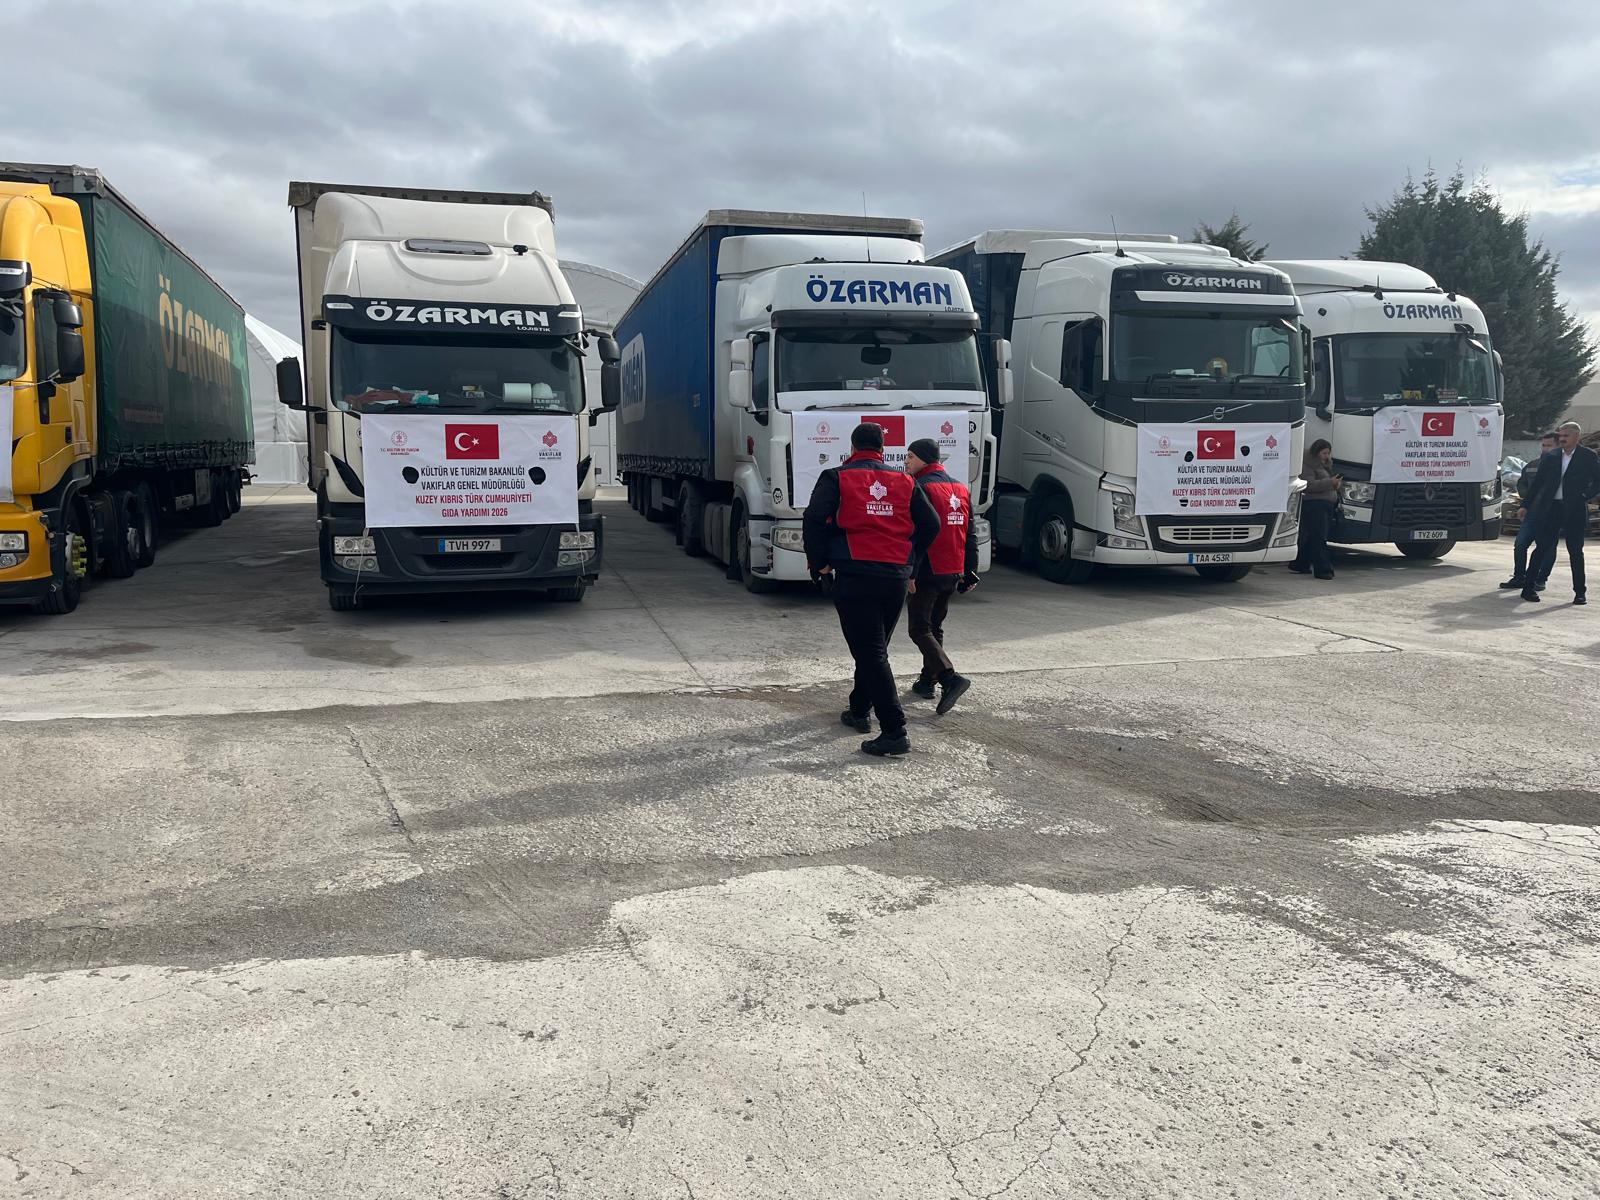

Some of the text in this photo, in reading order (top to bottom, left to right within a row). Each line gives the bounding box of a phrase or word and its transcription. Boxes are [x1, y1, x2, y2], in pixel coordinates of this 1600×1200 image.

[1166, 275, 1262, 289] ÖZARMAN
[806, 274, 952, 306] ÖZARMAN
[366, 301, 550, 327] ÖZARMAN
[1384, 302, 1462, 320] ÖZARMAN
[421, 465, 525, 476] KÜLTÜR VE TURİZM BAKANLIĞI
[1178, 465, 1197, 473] KÜLTÜR
[1226, 464, 1252, 472] BAKANLIĞI
[421, 479, 525, 490] VAKIFLAR GENEL MÜDÜRLÜĞÜ
[1220, 475, 1251, 484] MÜDÜRLÜĞÜ
[1208, 487, 1220, 495] TÜRK
[416, 492, 532, 504] KUZEY KIBRIS TÜRK CUMHURİYETİ
[442, 508, 508, 517] GIDA YARDIMI 2026
[449, 540, 490, 550] TVH 997
[1212, 554, 1230, 562] 453R
